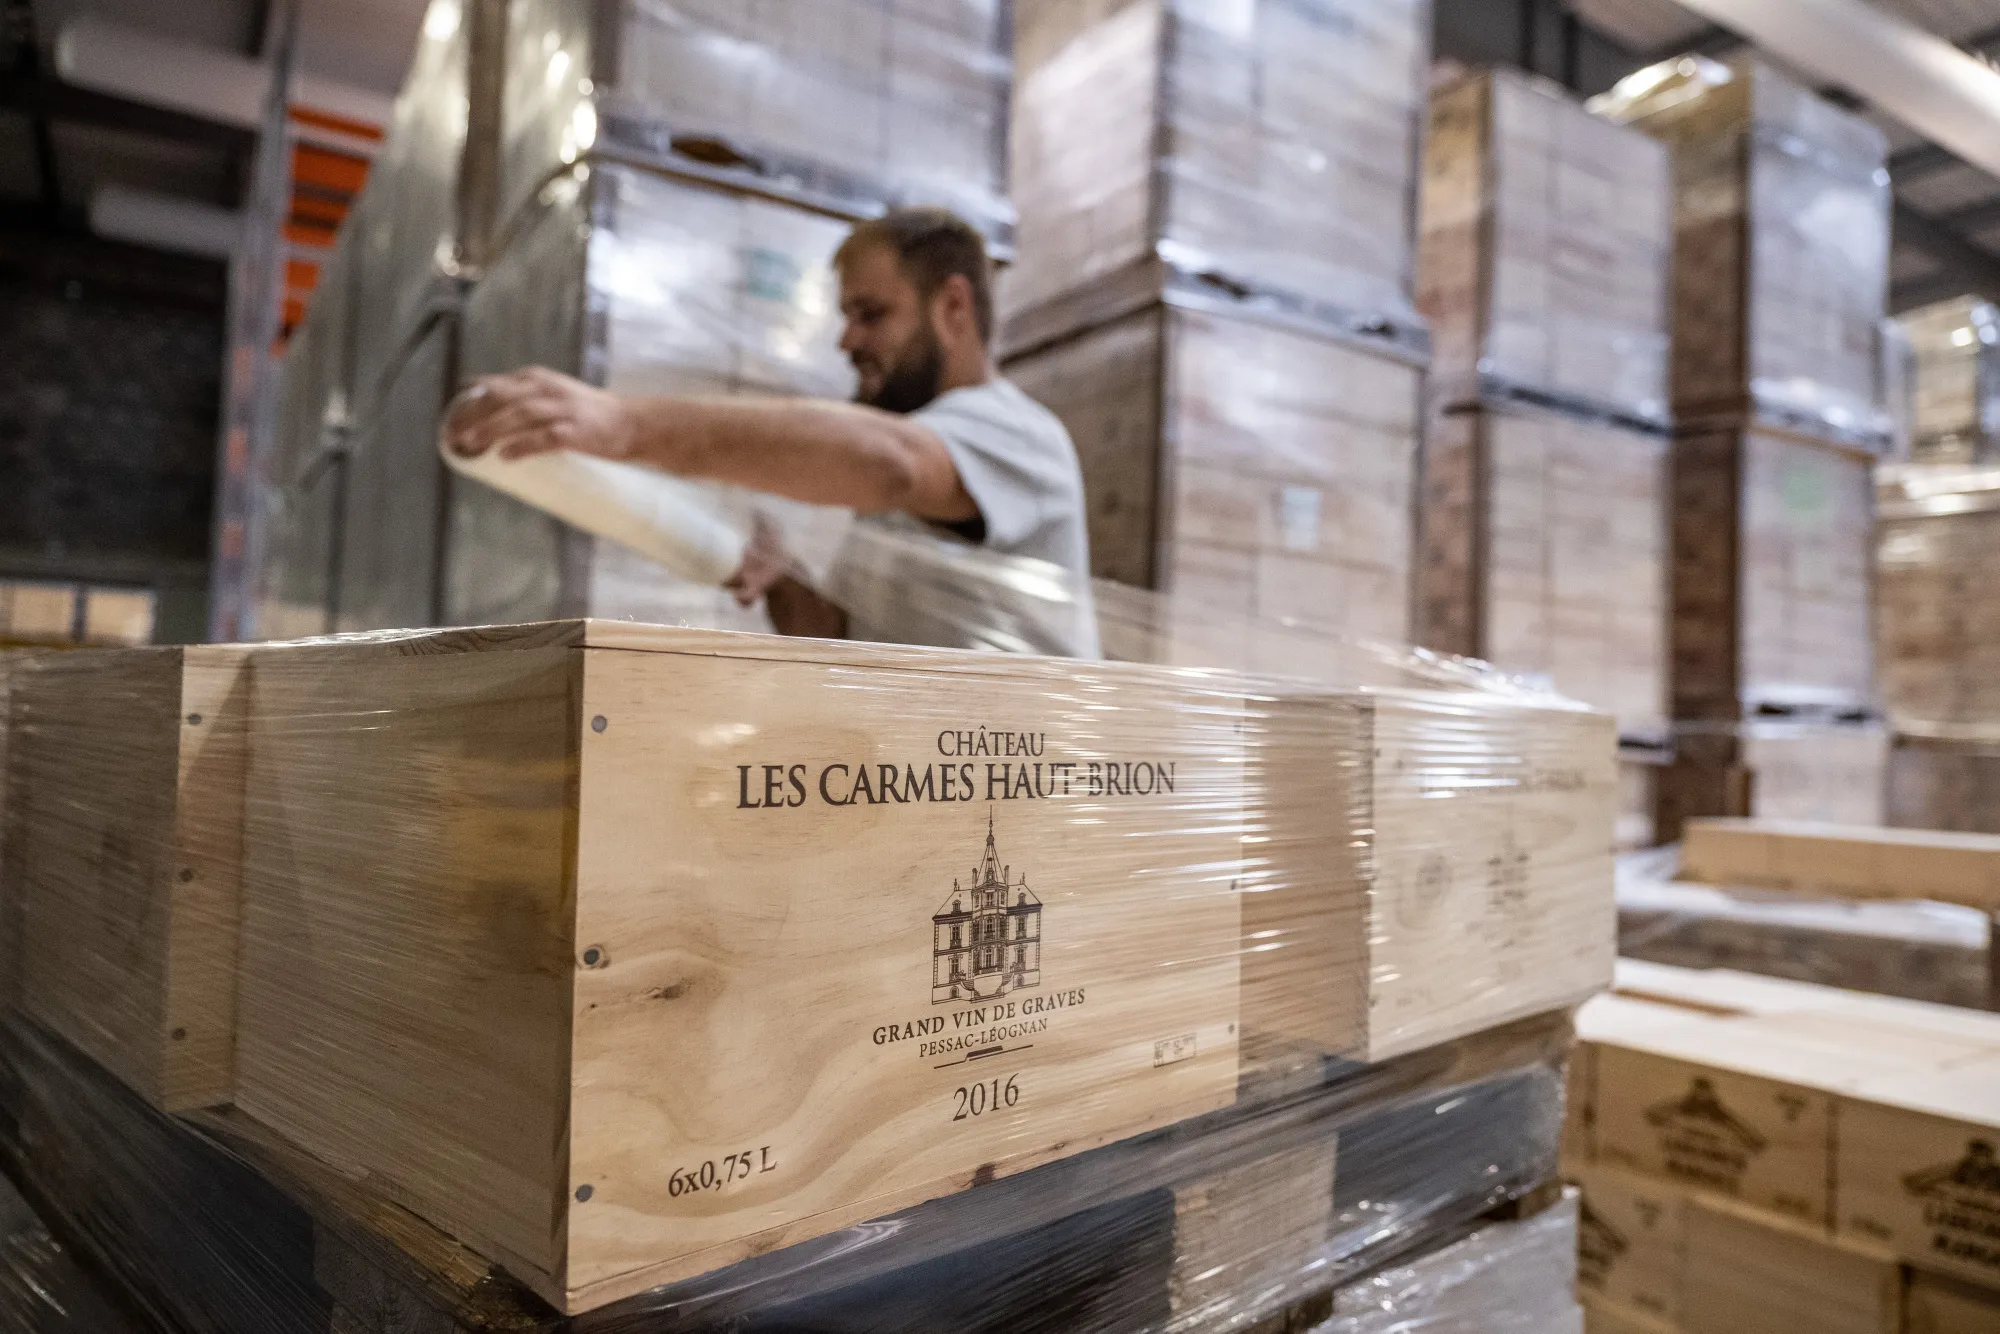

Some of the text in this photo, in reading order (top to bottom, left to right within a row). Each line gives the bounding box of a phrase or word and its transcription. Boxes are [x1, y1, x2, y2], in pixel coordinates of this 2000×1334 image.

[937, 725, 1045, 757] CHÂTEAU
[736, 761, 1176, 808] LES CARMES HAUT-BRION
[872, 988, 1085, 1045] GRAND VIN DE GRAVES
[919, 1017, 1048, 1058] PESSAC-LÉOGNAN
[952, 1072, 1020, 1121] 2016
[668, 1145, 777, 1197] 6x0,75 L
